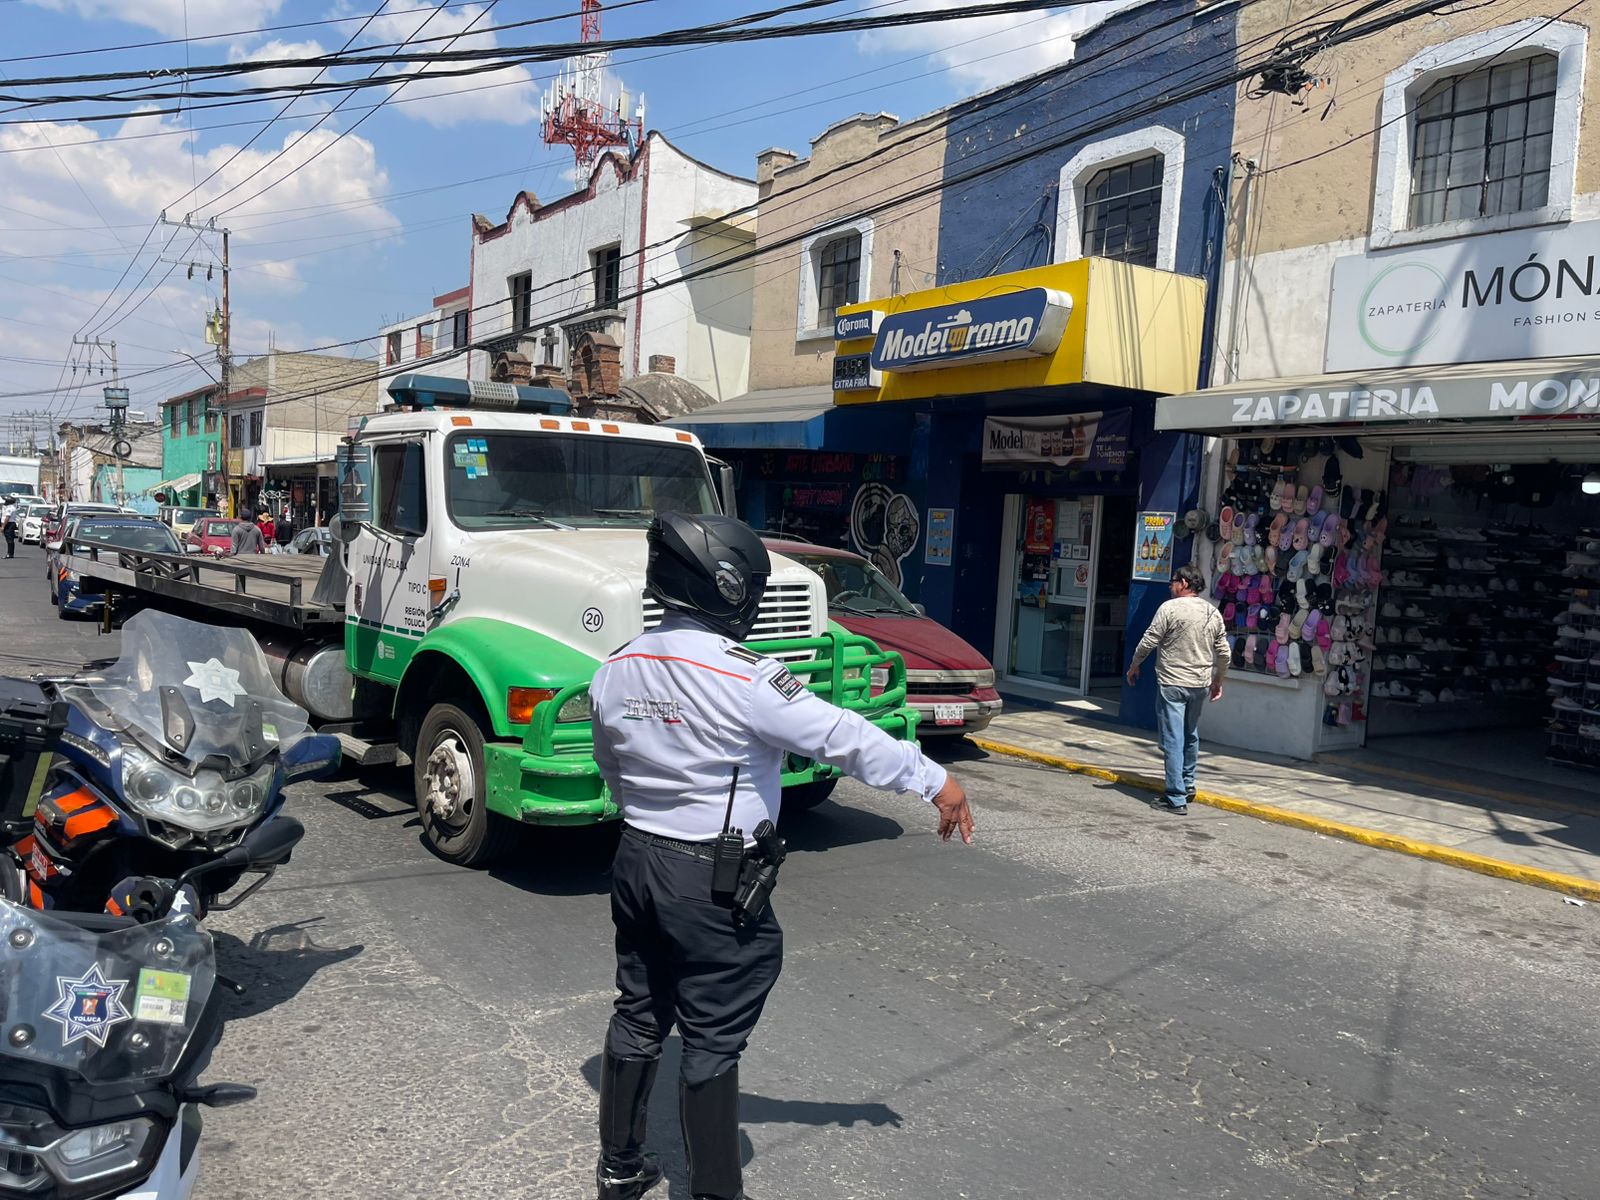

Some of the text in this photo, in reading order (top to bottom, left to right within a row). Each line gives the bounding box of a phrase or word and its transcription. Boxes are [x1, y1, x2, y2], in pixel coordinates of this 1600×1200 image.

[1461, 252, 1600, 309] MÓN
[1513, 311, 1586, 327] FASHION
[837, 318, 870, 336] Corona
[834, 379, 853, 389] EXTRA
[1231, 378, 1600, 422] ZAPATERIA MON
[450, 555, 471, 568] ZONA
[408, 582, 427, 595] TIPO C
[404, 606, 426, 618] REGIÓN
[404, 617, 426, 628] TOLUCA
[586, 613, 601, 626] 20
